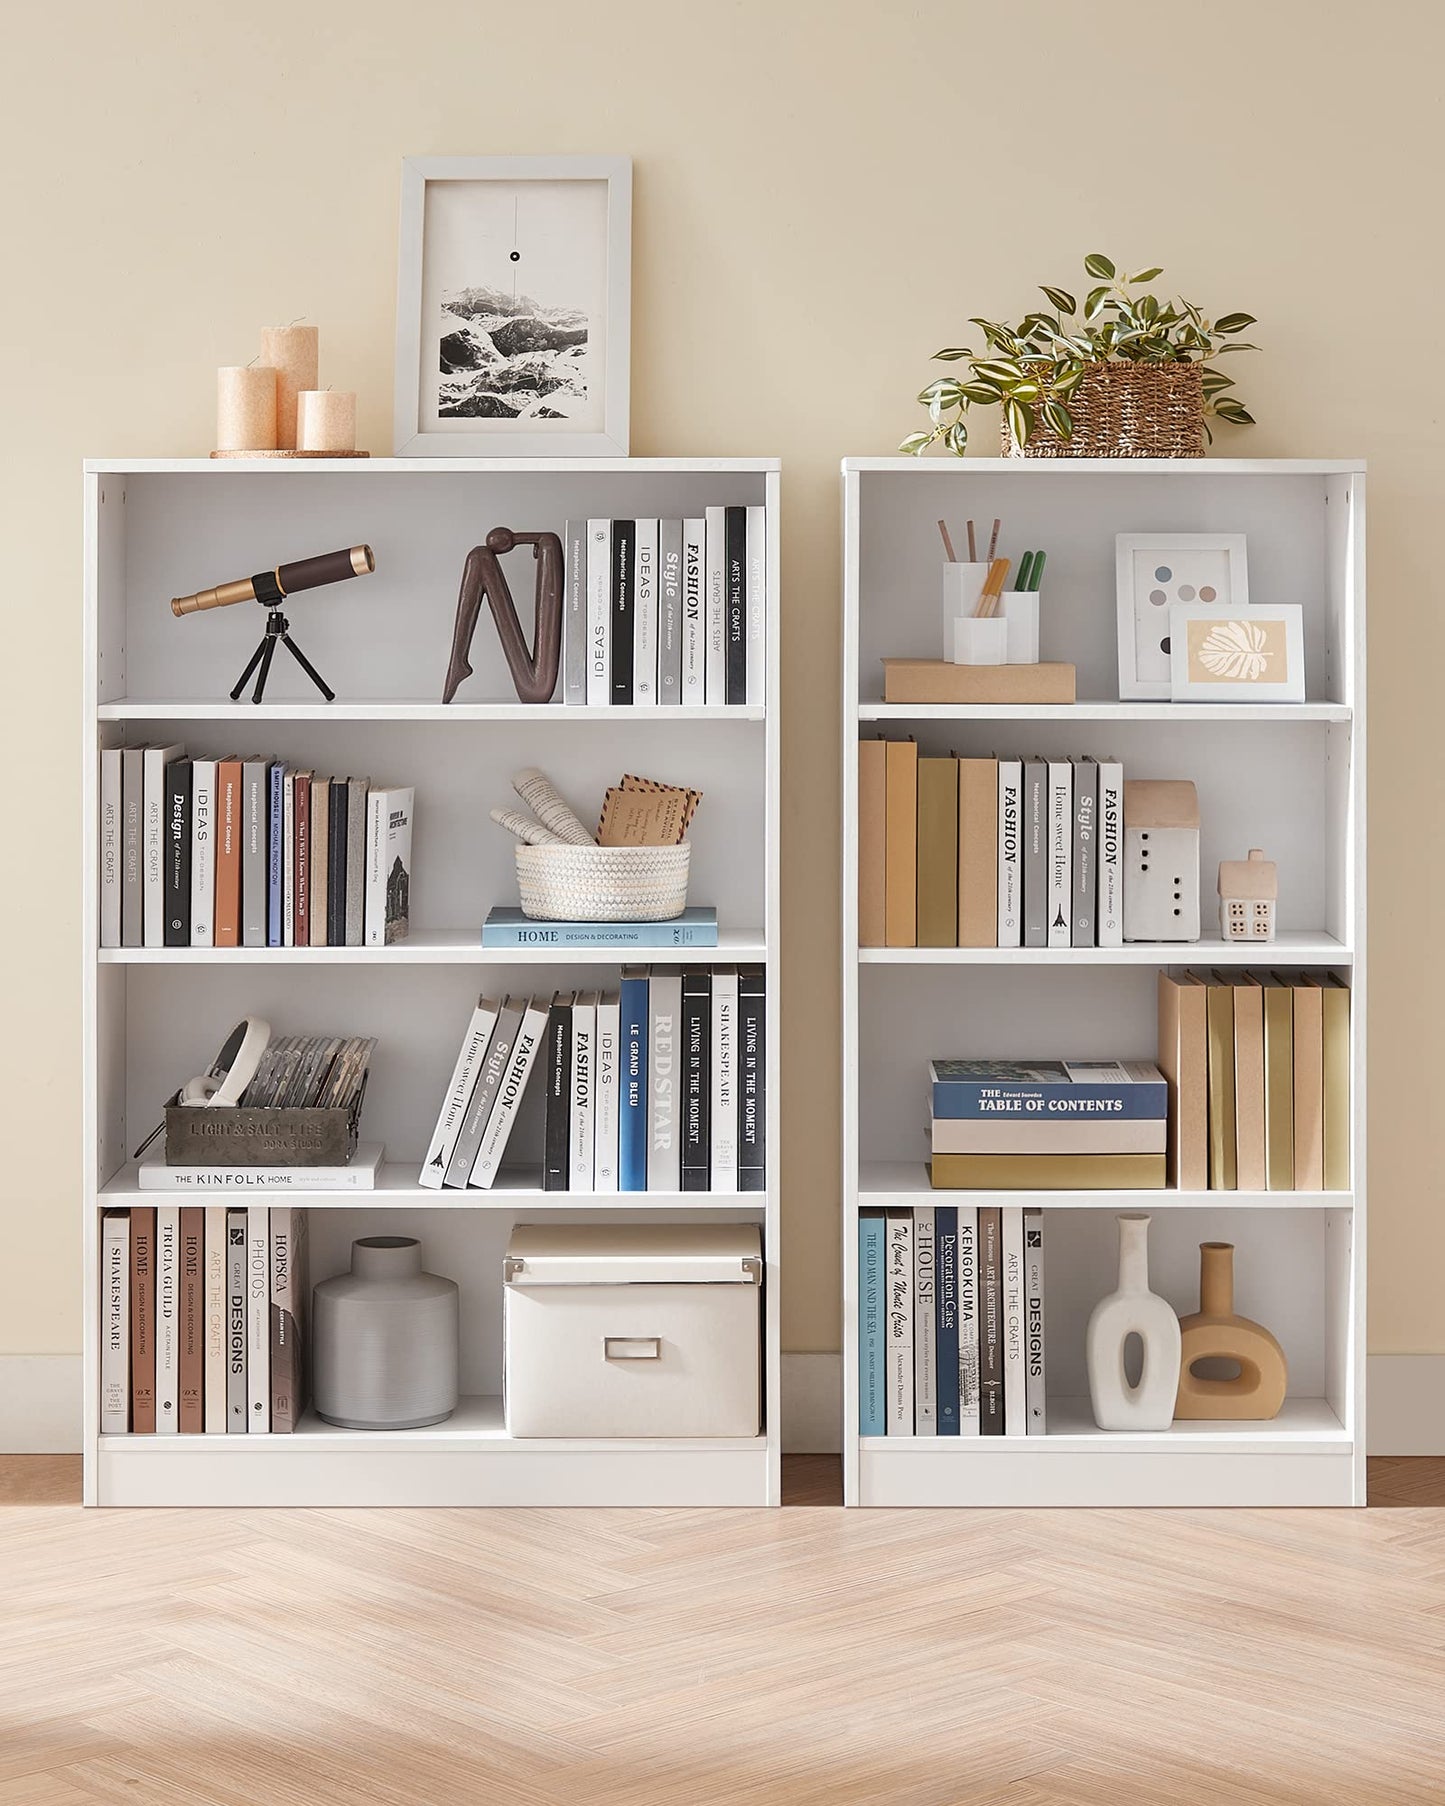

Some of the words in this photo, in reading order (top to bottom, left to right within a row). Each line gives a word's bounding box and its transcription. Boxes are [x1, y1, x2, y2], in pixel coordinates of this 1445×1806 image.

[641, 546, 650, 599] IDEAS
[664, 552, 678, 597] Style
[687, 543, 698, 620] FASHION
[732, 560, 740, 583] ARTS
[752, 557, 760, 583] ARTS
[732, 586, 740, 604] THE
[752, 586, 760, 604] THE
[732, 606, 740, 642] CRAFTS
[752, 606, 760, 640] CRAFTS
[595, 626, 604, 678] IDEAS
[171, 794, 184, 840] Design
[198, 790, 207, 840] IDEAS
[1056, 786, 1066, 817] Home
[1005, 786, 1016, 863] FASHION
[1078, 796, 1092, 841] Style
[1105, 788, 1117, 865] FASHION
[1056, 855, 1066, 888] Home
[518, 931, 559, 942] HOME
[630, 1024, 638, 1035] LE
[691, 1017, 700, 1052] LIVING
[747, 1017, 756, 1053] LIVING
[467, 1032, 485, 1064] Home
[486, 1042, 508, 1085] Style
[602, 1033, 612, 1084] IDEAS
[630, 1041, 638, 1076] GRAND
[690, 1058, 700, 1068] IN
[721, 1004, 729, 1107] SHAKESPEARE
[747, 1058, 756, 1068] IN
[456, 1066, 470, 1094] sweet
[502, 1034, 534, 1110] FASHION
[577, 1032, 588, 1108] FASHION
[690, 1072, 699, 1093] THE
[746, 1072, 756, 1094] THE
[630, 1082, 638, 1106] BLEU
[978, 1100, 1021, 1111] TABLE
[1026, 1100, 1045, 1111] OF
[1048, 1100, 1123, 1111] CONTENTS
[191, 1123, 232, 1136] LIGHT
[233, 1123, 244, 1136] &
[248, 1123, 280, 1136] SALT
[290, 1123, 322, 1136] LIFE
[445, 1098, 463, 1130] Home
[690, 1099, 699, 1143] MOMENT
[746, 1099, 755, 1144] MOMENT
[196, 1174, 265, 1184] KINFOLK
[268, 1176, 292, 1184] HOME
[867, 1233, 876, 1248] THE
[894, 1226, 908, 1240] The
[918, 1223, 932, 1232] PC
[137, 1236, 147, 1276] HOME
[164, 1224, 172, 1272] TRICIA
[187, 1236, 197, 1276] HOME
[275, 1235, 287, 1293] HOPSCA
[867, 1250, 876, 1266] OLD
[892, 1243, 908, 1266] Count
[211, 1251, 220, 1279] ARTS
[252, 1240, 264, 1299] PHOTOS
[867, 1268, 876, 1285] MAN
[919, 1237, 932, 1304] HOUSE
[945, 1235, 956, 1298] Decoration
[962, 1226, 972, 1321] KENGOKUMA
[987, 1265, 996, 1280] ART
[1009, 1253, 1018, 1282] ARTS
[111, 1248, 120, 1351] SHAKESPEARE
[164, 1276, 172, 1318] GUILD
[211, 1285, 220, 1308] THE
[867, 1287, 876, 1304] AND
[894, 1281, 907, 1309] Monte
[1009, 1288, 1018, 1311] THE
[867, 1306, 876, 1321] THE
[867, 1322, 876, 1334] SEA
[892, 1312, 908, 1338] Cristo
[945, 1300, 956, 1328] Case
[987, 1287, 996, 1344] ARCHITECTURE
[211, 1314, 220, 1358] CRAFTS
[232, 1296, 243, 1374] DESIGNS
[1009, 1316, 1019, 1360] CRAFTS
[1030, 1298, 1041, 1376] DESIGNS
